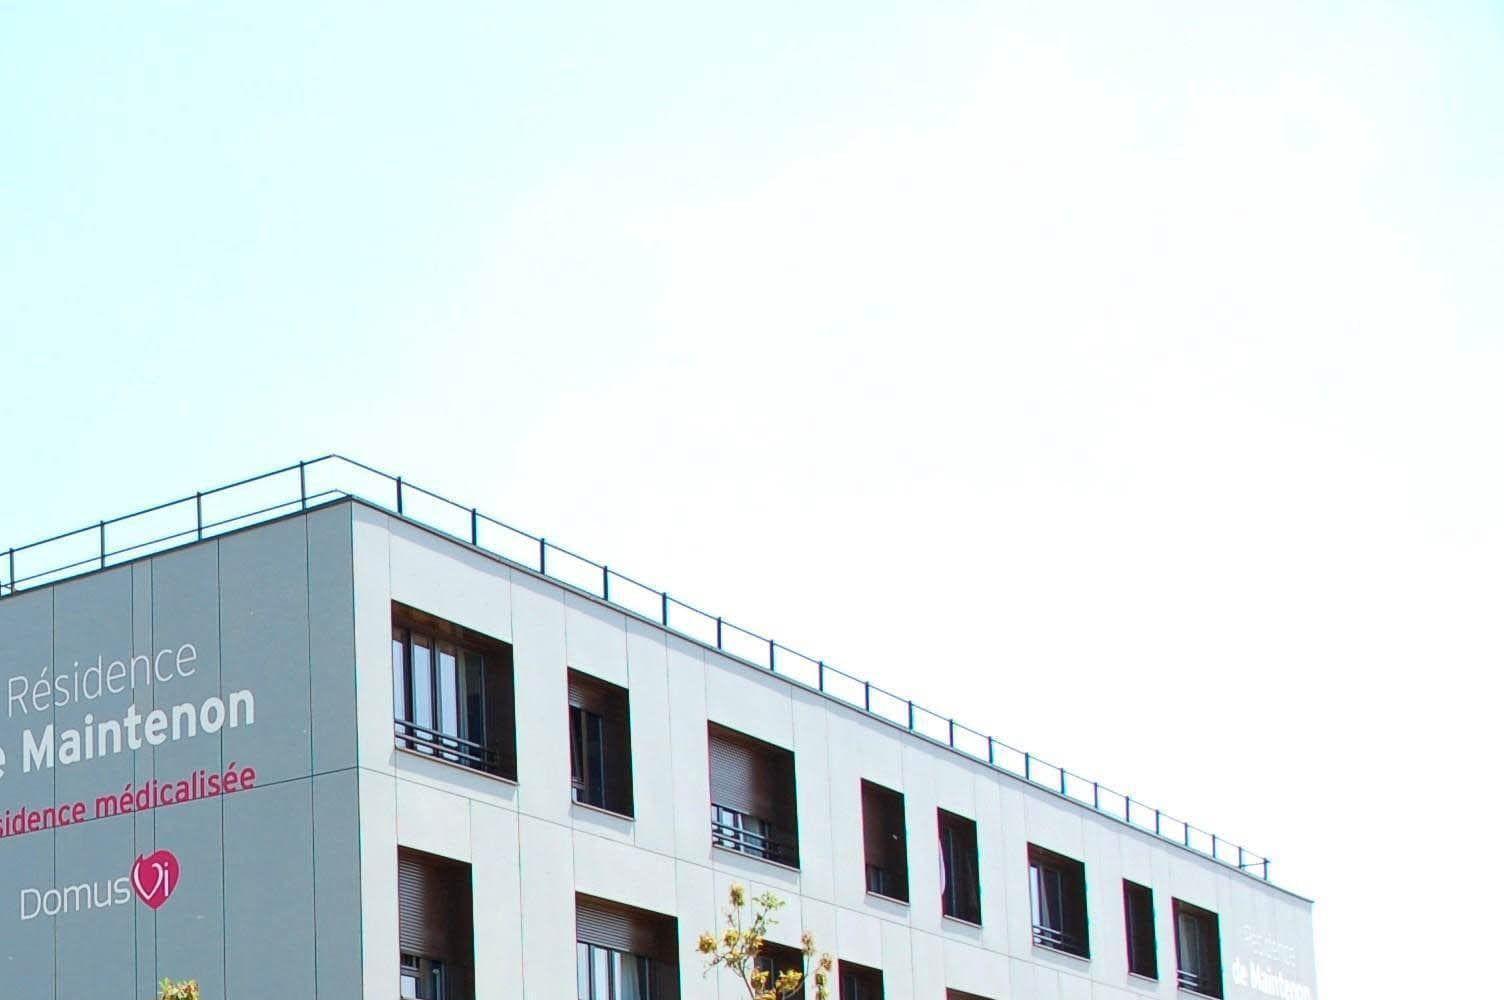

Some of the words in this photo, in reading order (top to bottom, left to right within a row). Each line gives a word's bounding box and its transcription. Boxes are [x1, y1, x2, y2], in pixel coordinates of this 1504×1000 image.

[7, 643, 197, 718] Résidence
[22, 689, 256, 773] Maintenon
[95, 762, 257, 819] médicalisée
